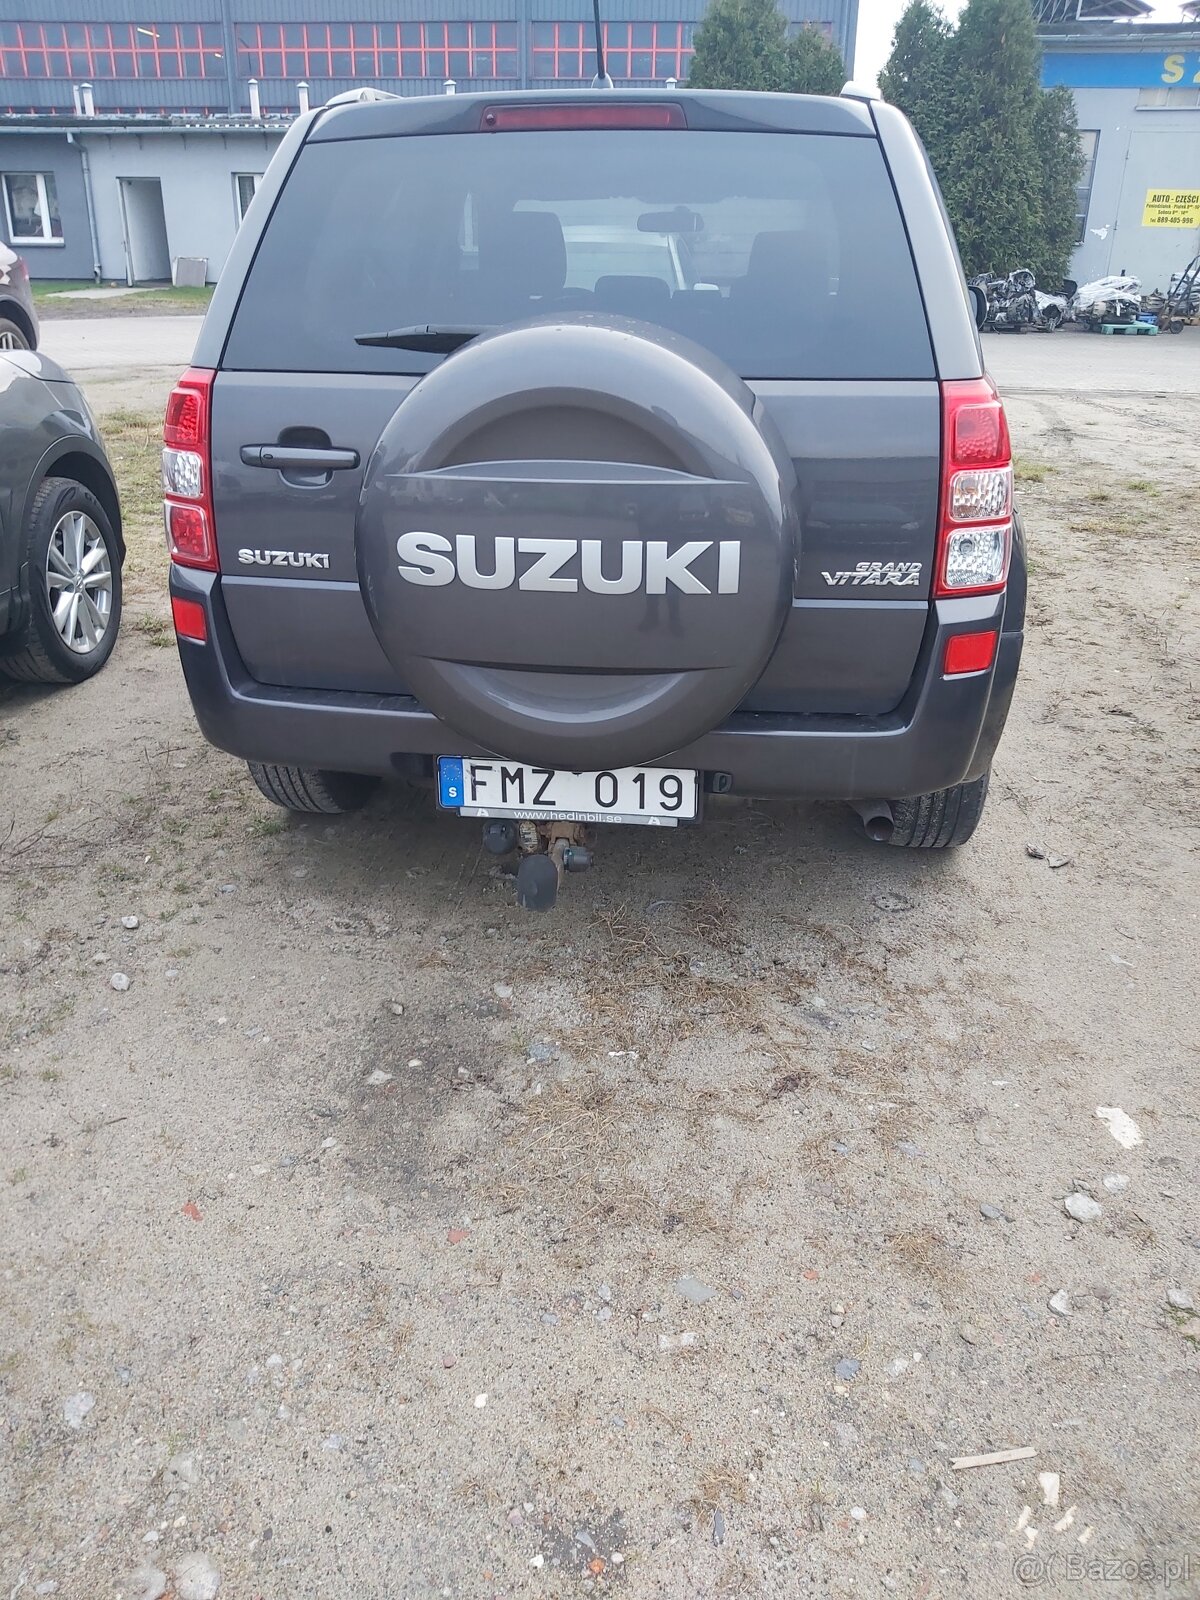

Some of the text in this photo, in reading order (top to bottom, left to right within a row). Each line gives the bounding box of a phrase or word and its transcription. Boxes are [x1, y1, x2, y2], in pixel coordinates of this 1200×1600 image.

[1152, 194, 1170, 203] AUTO
[1175, 194, 1199, 203] CZĘŚCI
[237, 548, 330, 569] SUZUKI
[396, 530, 741, 595] SUZUKI
[855, 561, 922, 572] GRAND
[821, 571, 920, 586] VITARA
[448, 786, 457, 797] S
[470, 765, 684, 811] FMZ 019
[512, 810, 623, 823] www.hedinbil.se
